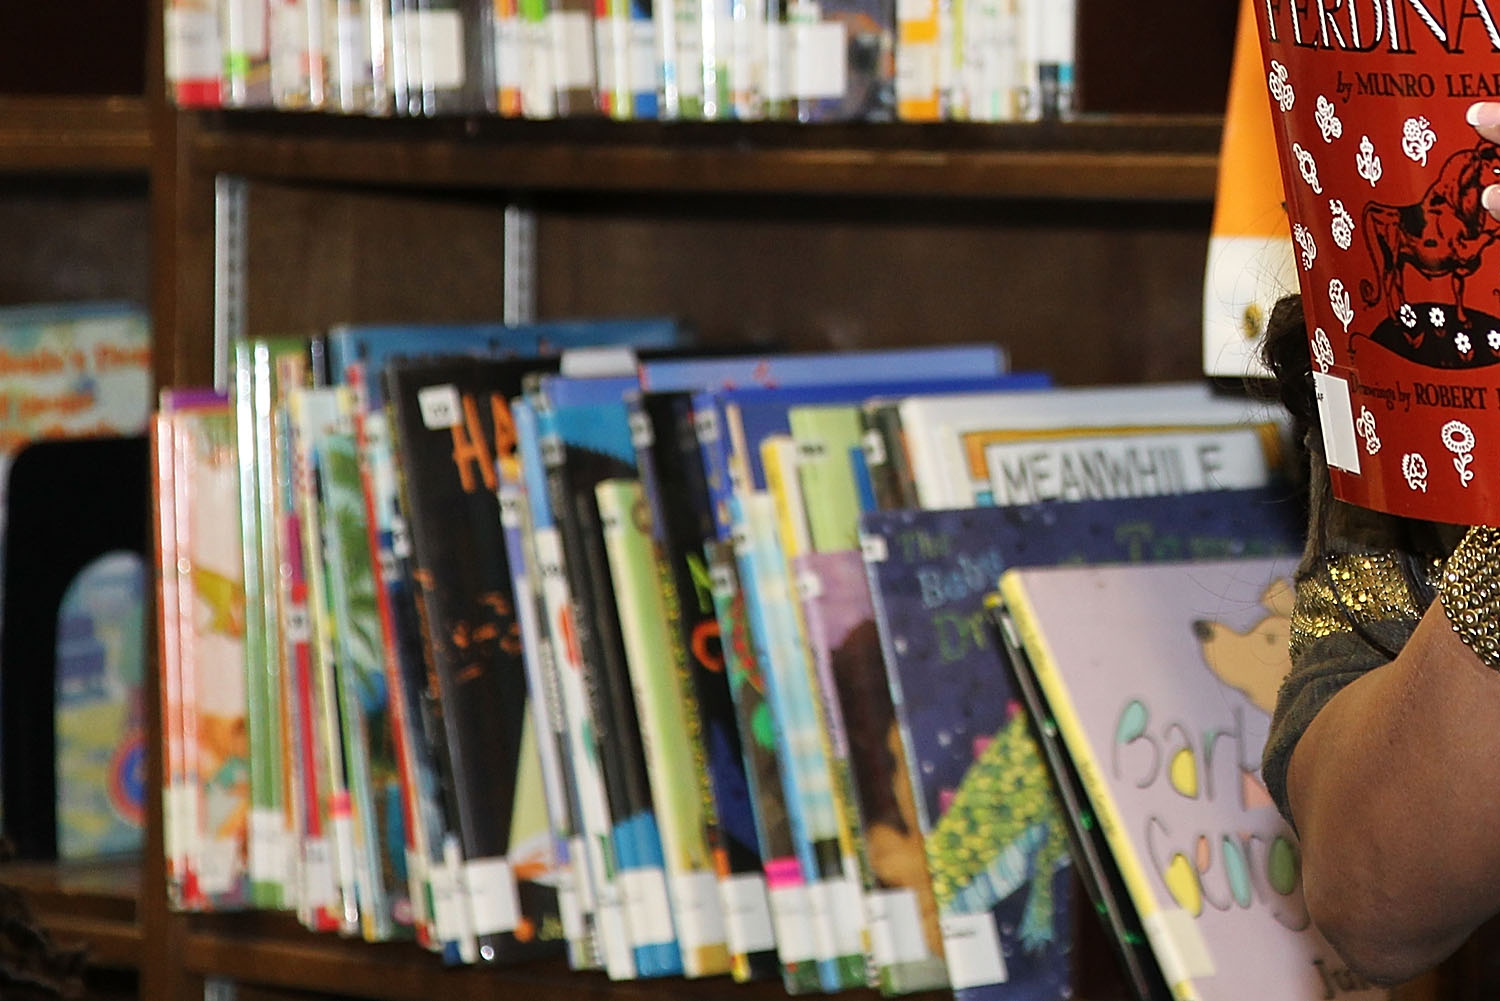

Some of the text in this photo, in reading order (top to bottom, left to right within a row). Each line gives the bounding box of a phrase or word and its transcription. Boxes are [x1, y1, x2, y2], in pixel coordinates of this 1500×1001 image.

[1336, 71, 1352, 101] by
[1355, 72, 1436, 99] MUNRO
[1414, 381, 1488, 412] ROBERT
